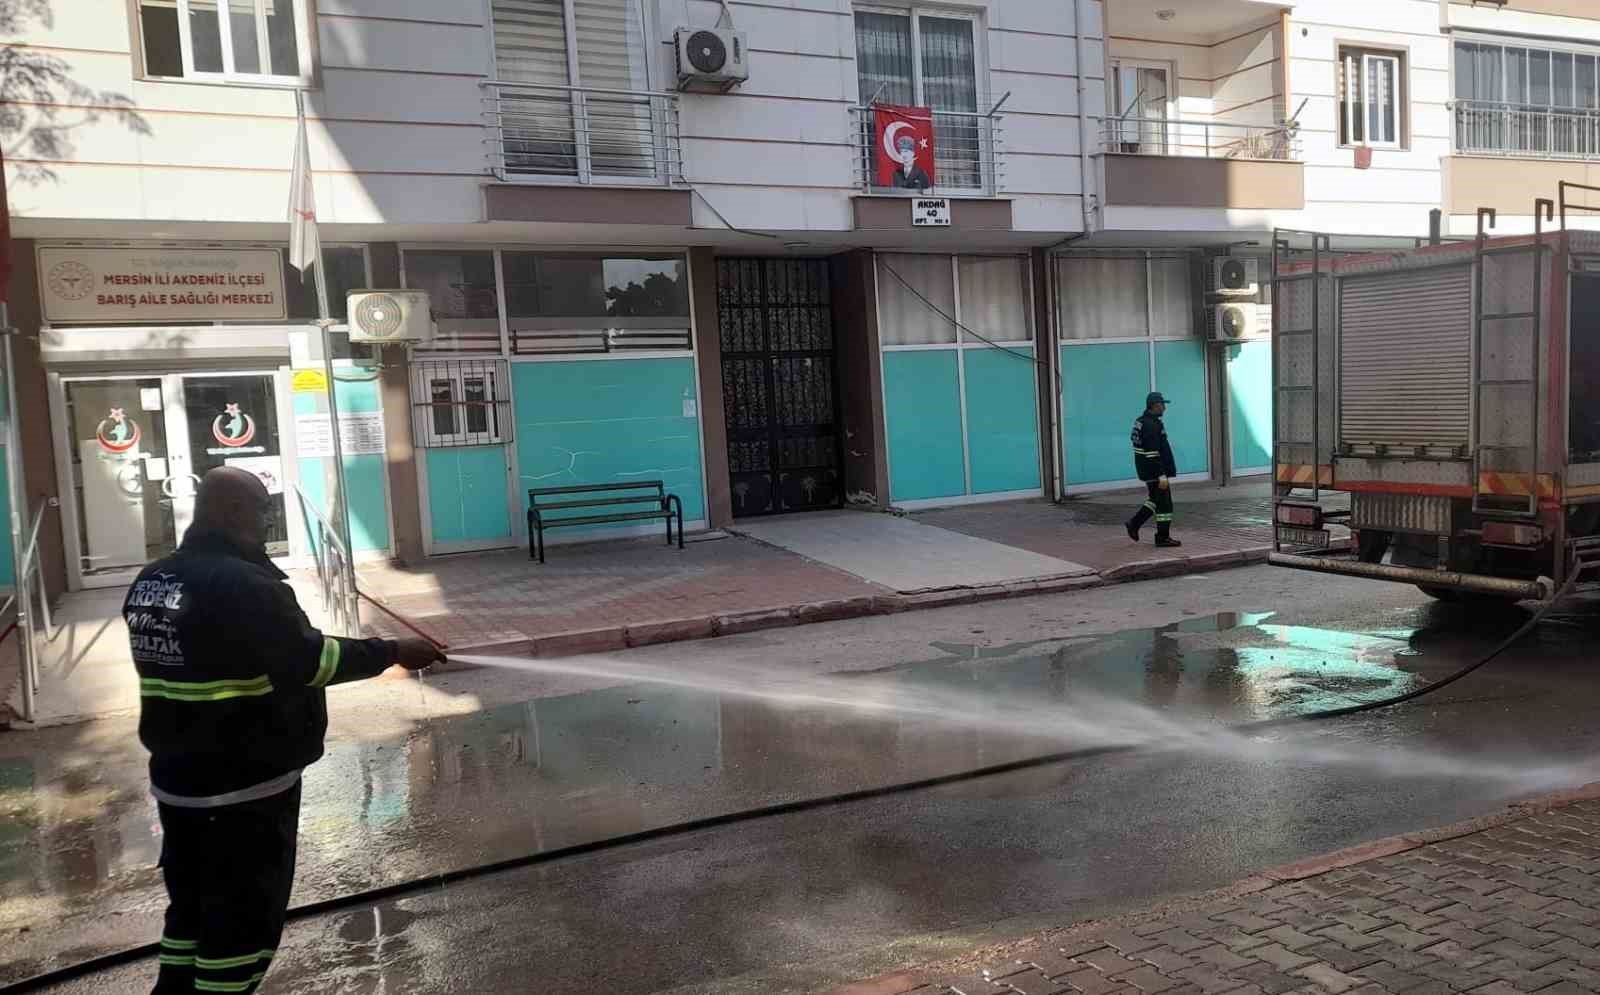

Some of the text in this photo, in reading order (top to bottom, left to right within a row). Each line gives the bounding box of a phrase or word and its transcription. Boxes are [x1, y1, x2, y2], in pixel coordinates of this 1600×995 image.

[103, 271, 265, 288] MERSİN İLİ AKDENİZ İLÇESİ
[97, 291, 274, 308] BARIŞ AİLE SAĞLIĞI MERKEZİ
